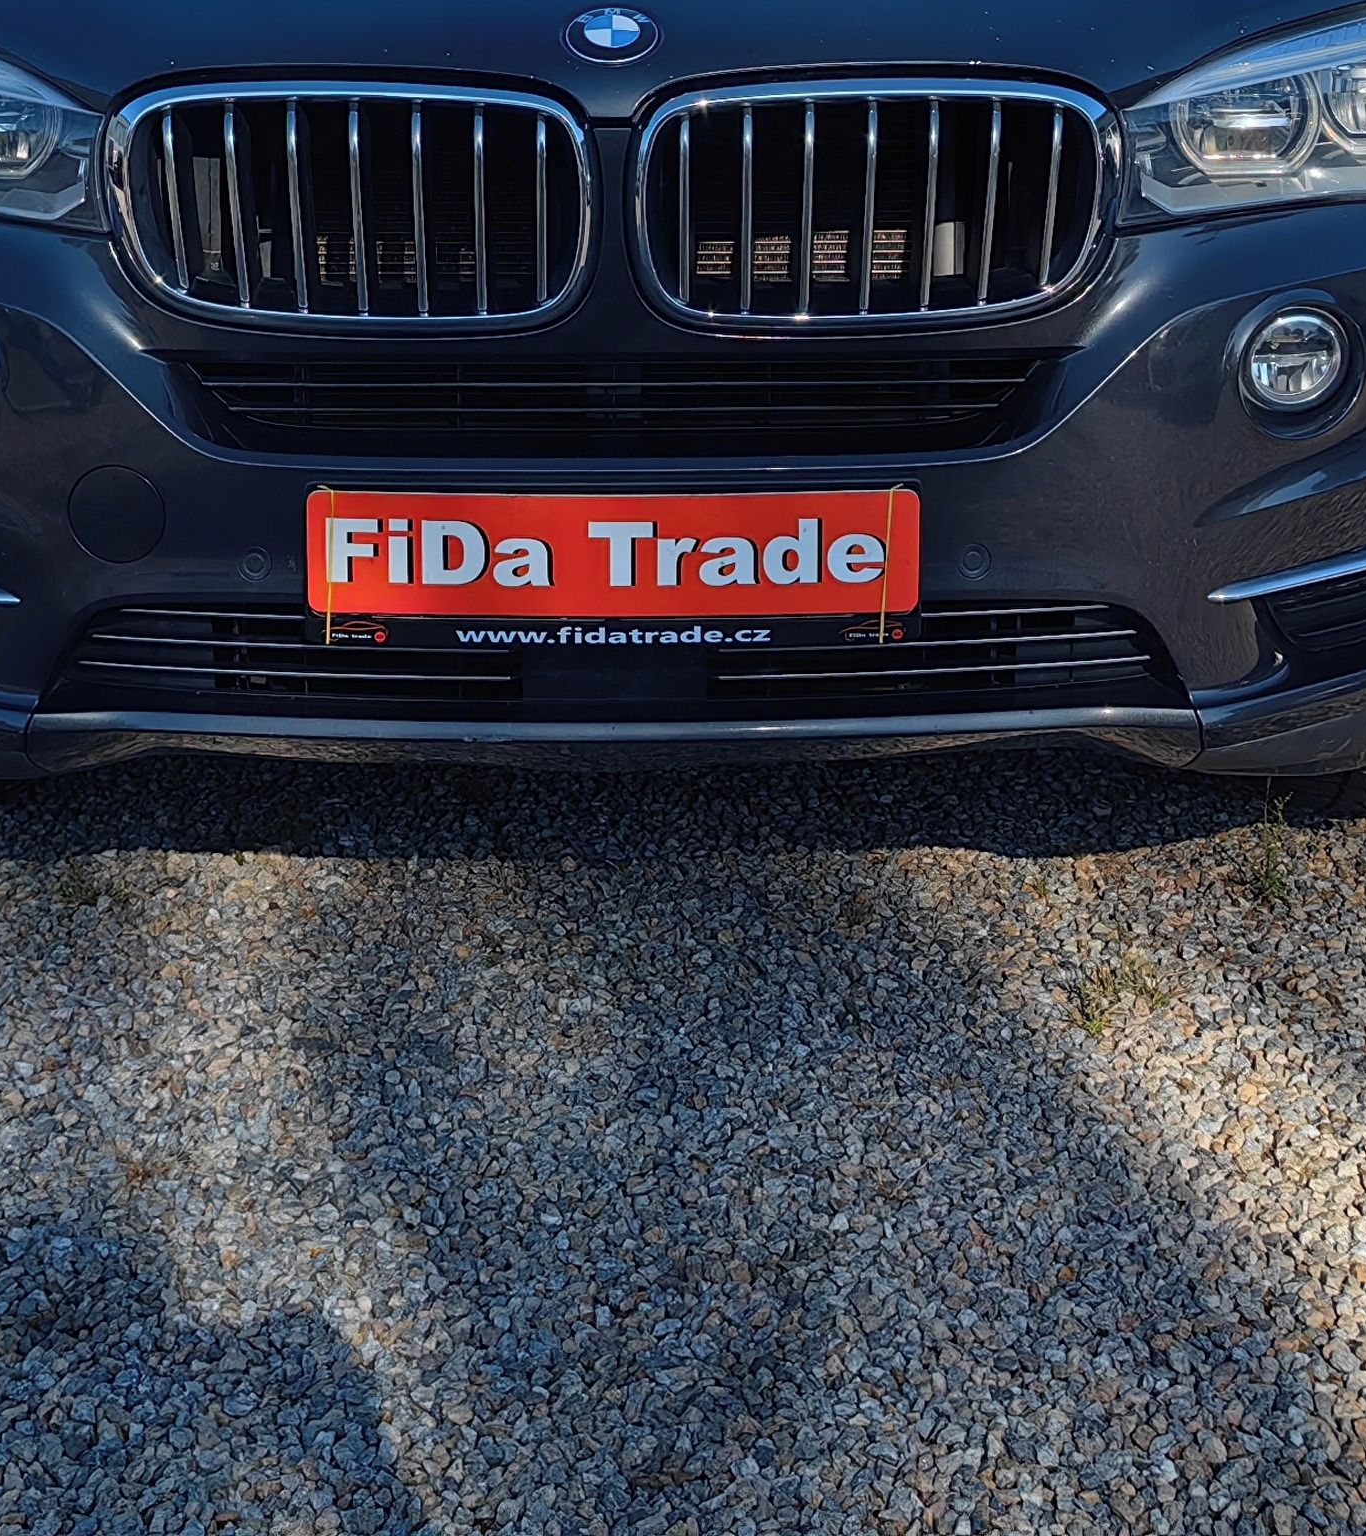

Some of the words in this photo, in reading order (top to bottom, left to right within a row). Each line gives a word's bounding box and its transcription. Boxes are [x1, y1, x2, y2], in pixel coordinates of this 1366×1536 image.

[324, 517, 555, 587] FiDa
[587, 518, 886, 587] Trade
[455, 625, 772, 644] www.fidatrade.cz
